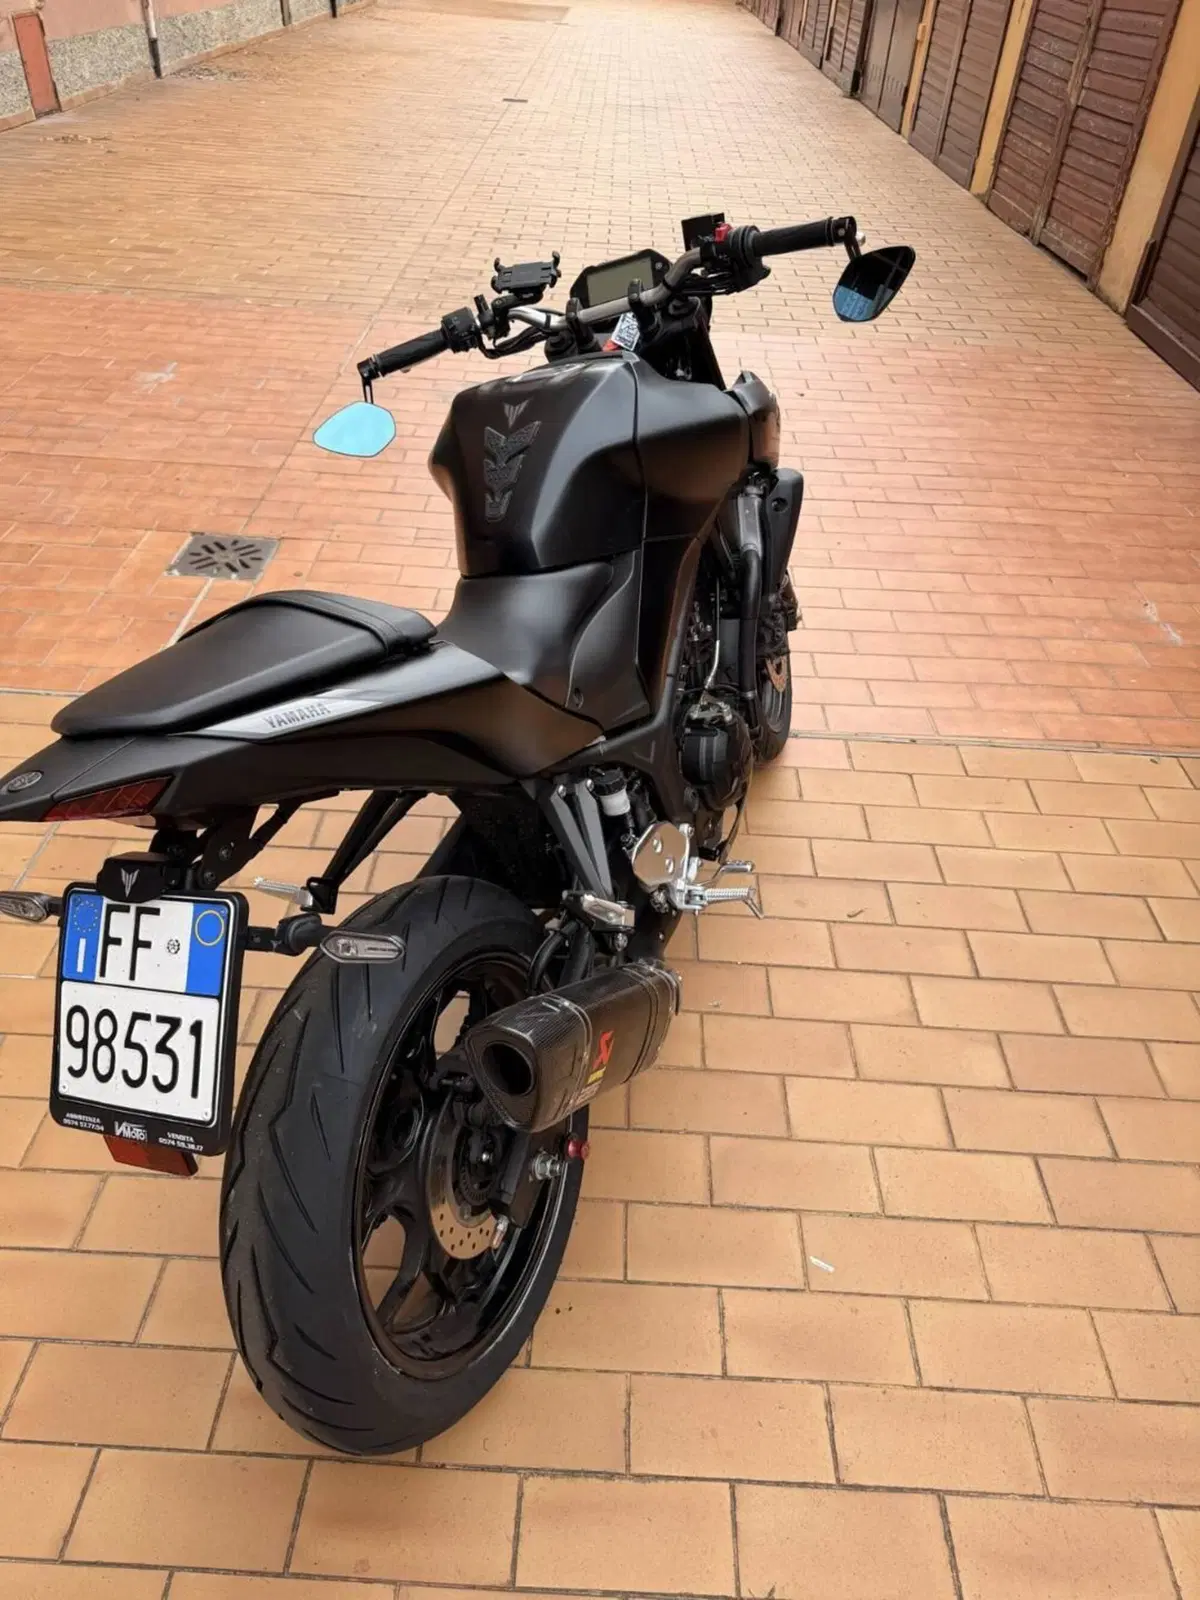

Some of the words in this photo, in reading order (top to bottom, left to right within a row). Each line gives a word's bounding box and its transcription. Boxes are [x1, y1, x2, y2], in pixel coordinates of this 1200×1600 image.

[263, 703, 331, 728] YAMAHA
[99, 904, 161, 981] FF
[66, 1004, 203, 1099] 98531
